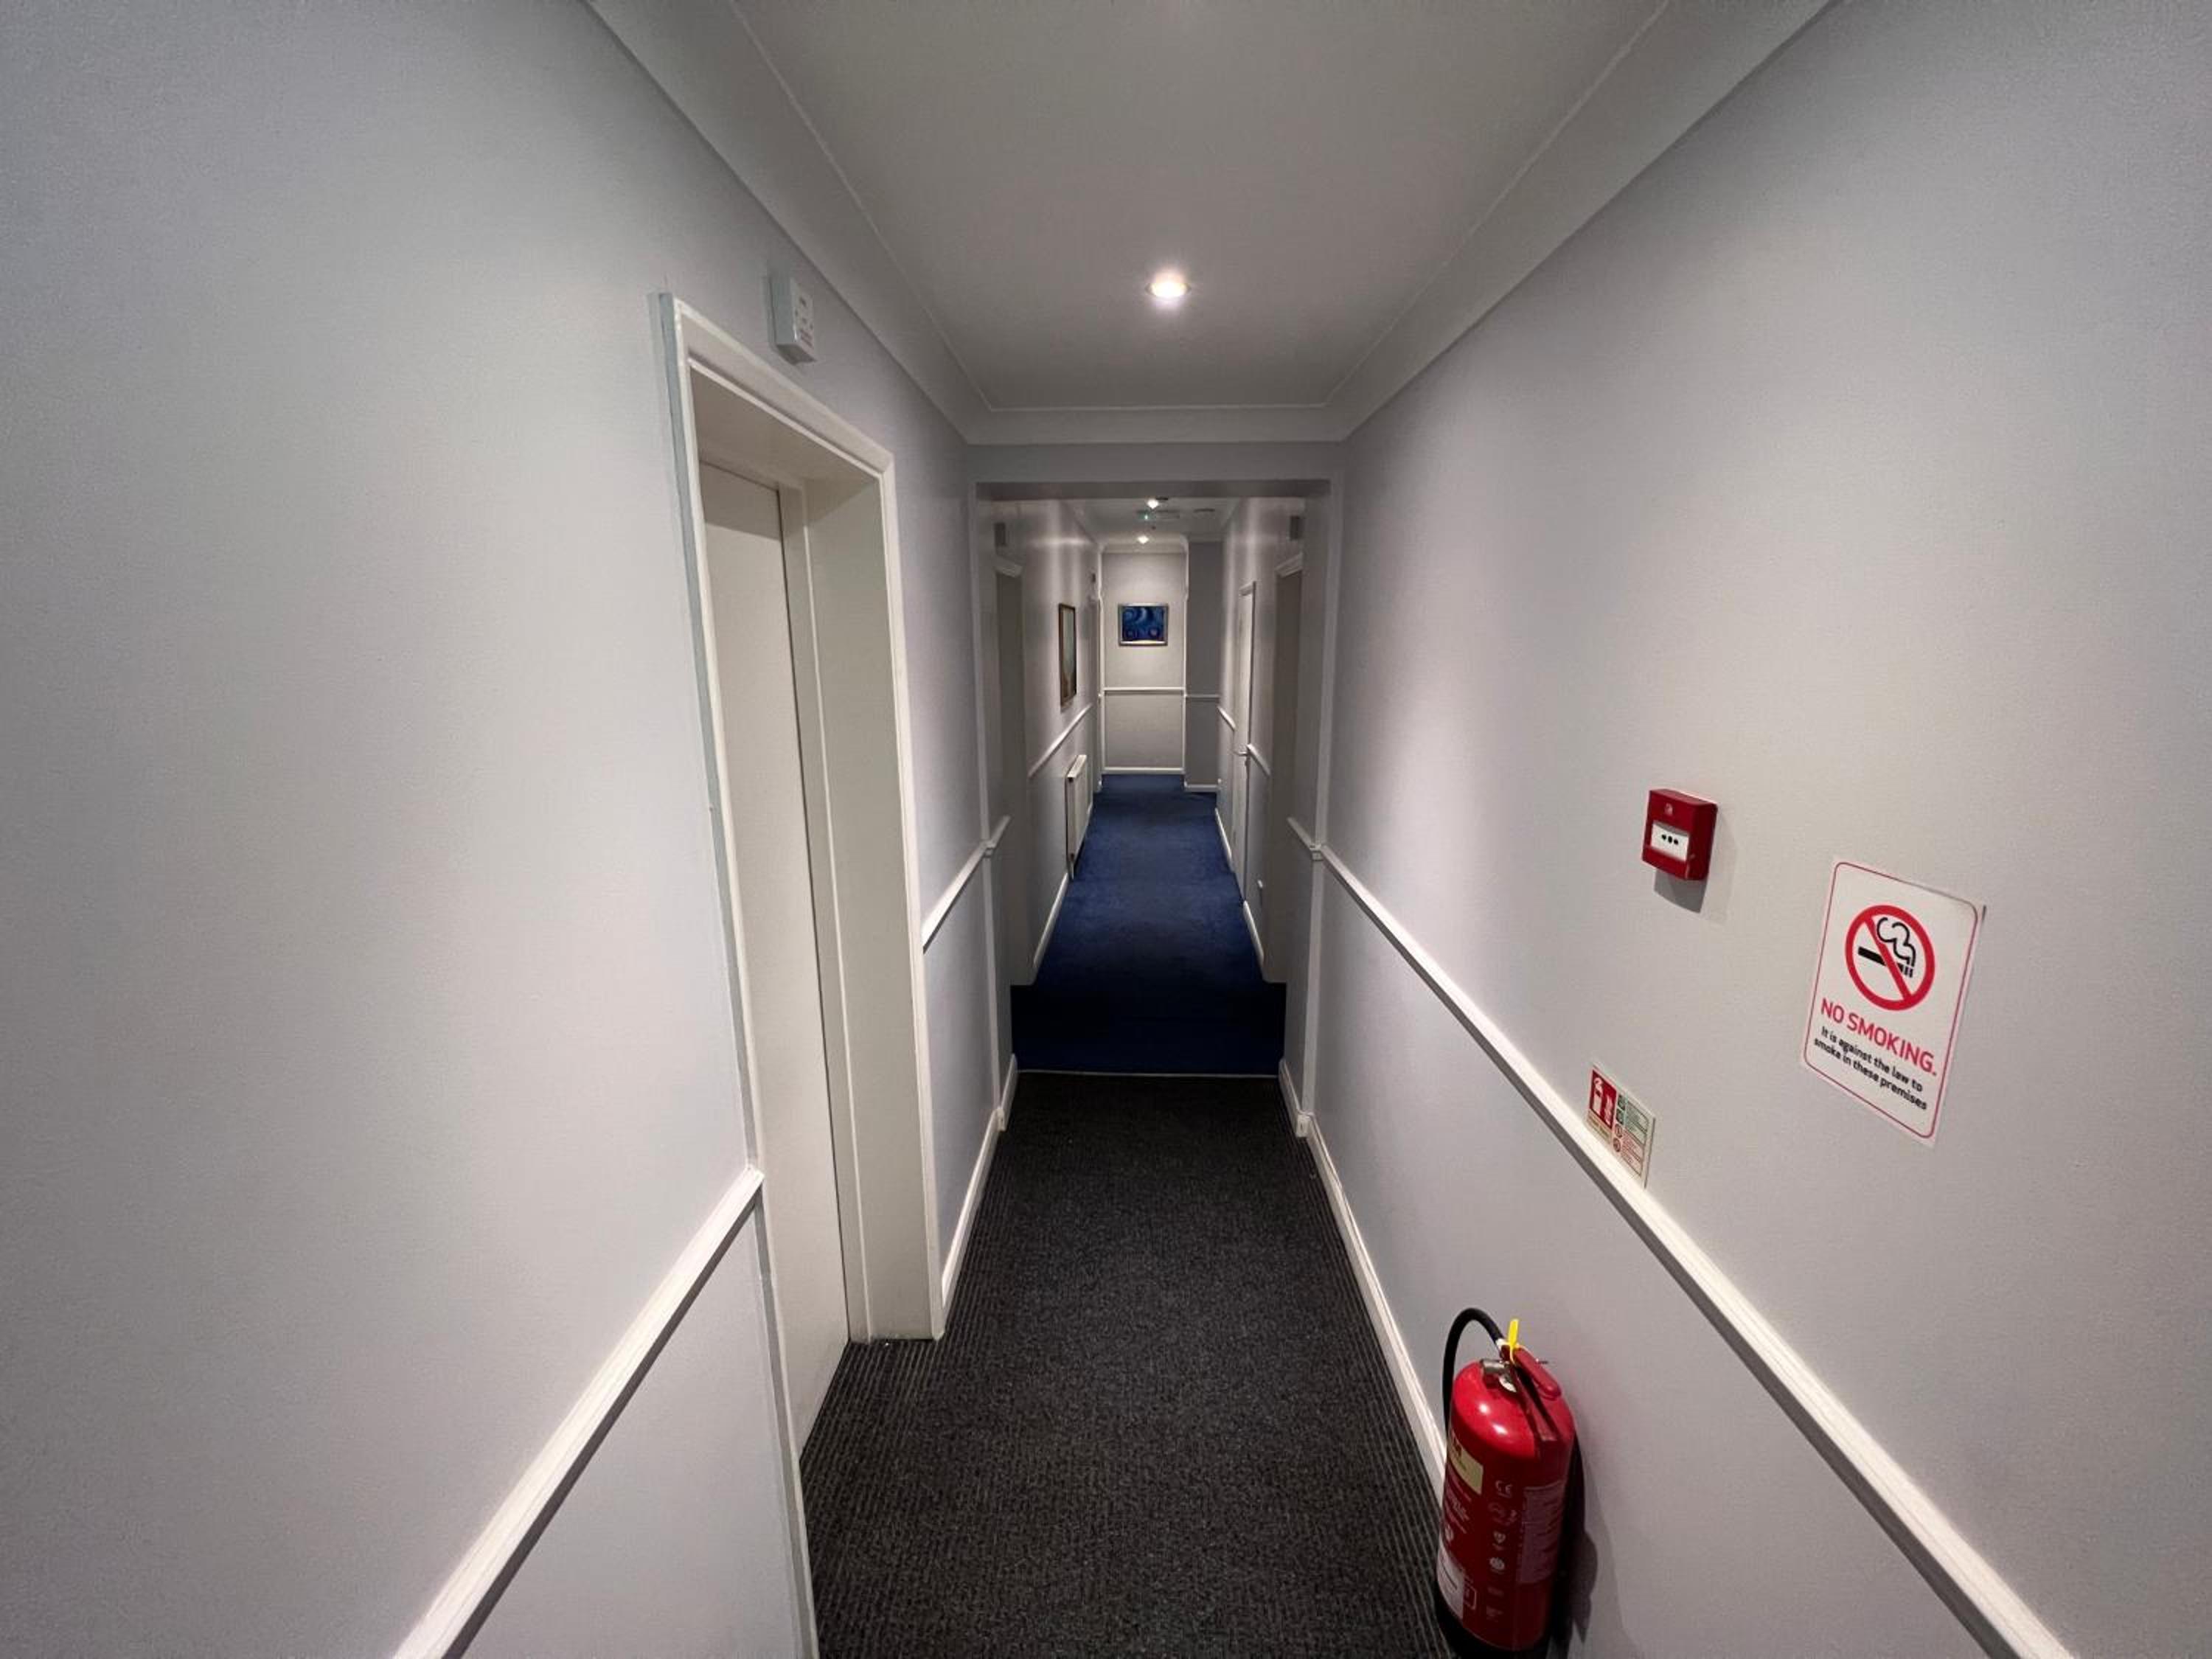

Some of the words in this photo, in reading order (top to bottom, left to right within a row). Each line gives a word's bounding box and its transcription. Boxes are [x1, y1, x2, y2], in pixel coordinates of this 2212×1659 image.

[1821, 998, 1844, 1023] NO
[1847, 1012, 1937, 1077] SMOKING.
[1822, 1026, 1828, 1037] It
[1830, 1032, 1837, 1043] is
[1839, 1037, 1872, 1063] against
[1874, 1057, 1890, 1074] the
[1892, 1066, 1909, 1084] law
[1912, 1079, 1923, 1092] to
[1815, 1038, 1841, 1060] smoke
[1843, 1053, 1851, 1065] in
[1853, 1060, 1879, 1082] these
[1880, 1077, 1927, 1110] premises
